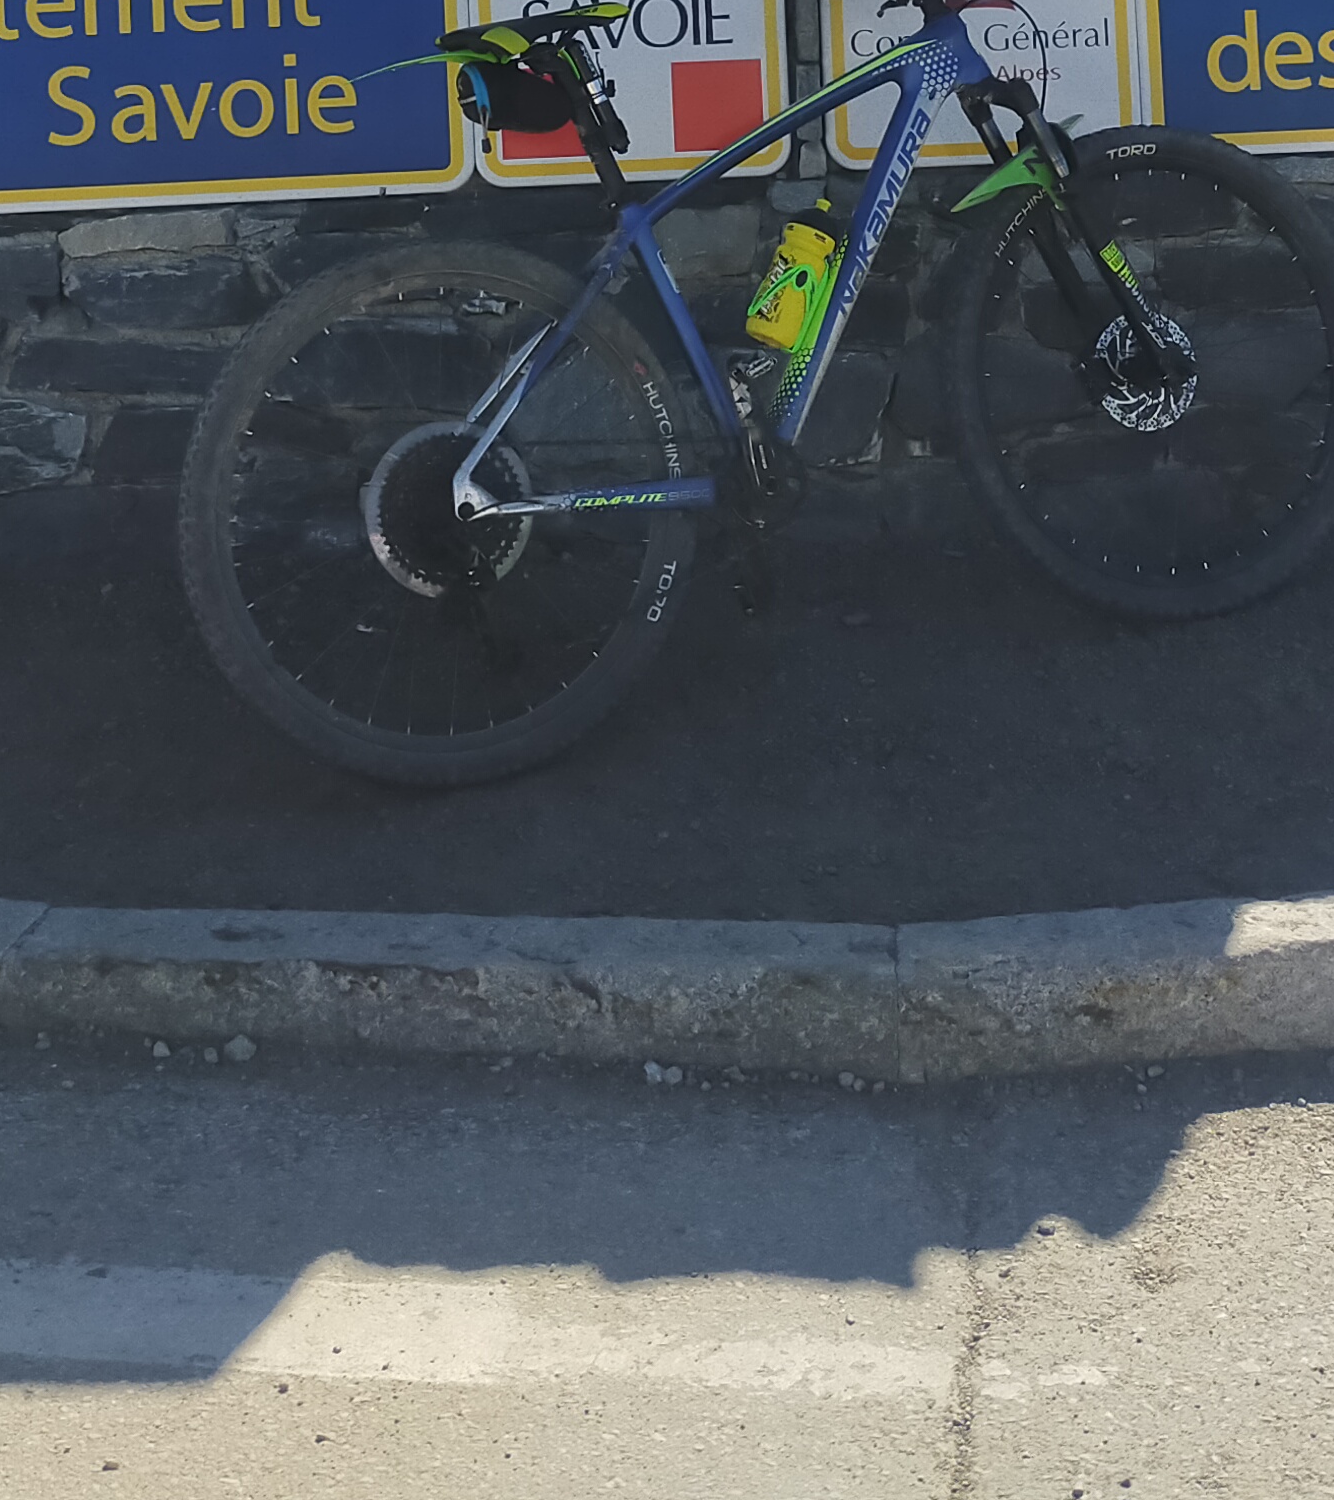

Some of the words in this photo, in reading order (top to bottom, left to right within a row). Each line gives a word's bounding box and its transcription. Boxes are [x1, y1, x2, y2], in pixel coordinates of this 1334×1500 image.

[983, 17, 1110, 52] Général
[996, 64, 1062, 81] Alpes
[49, 54, 358, 147] Savoie
